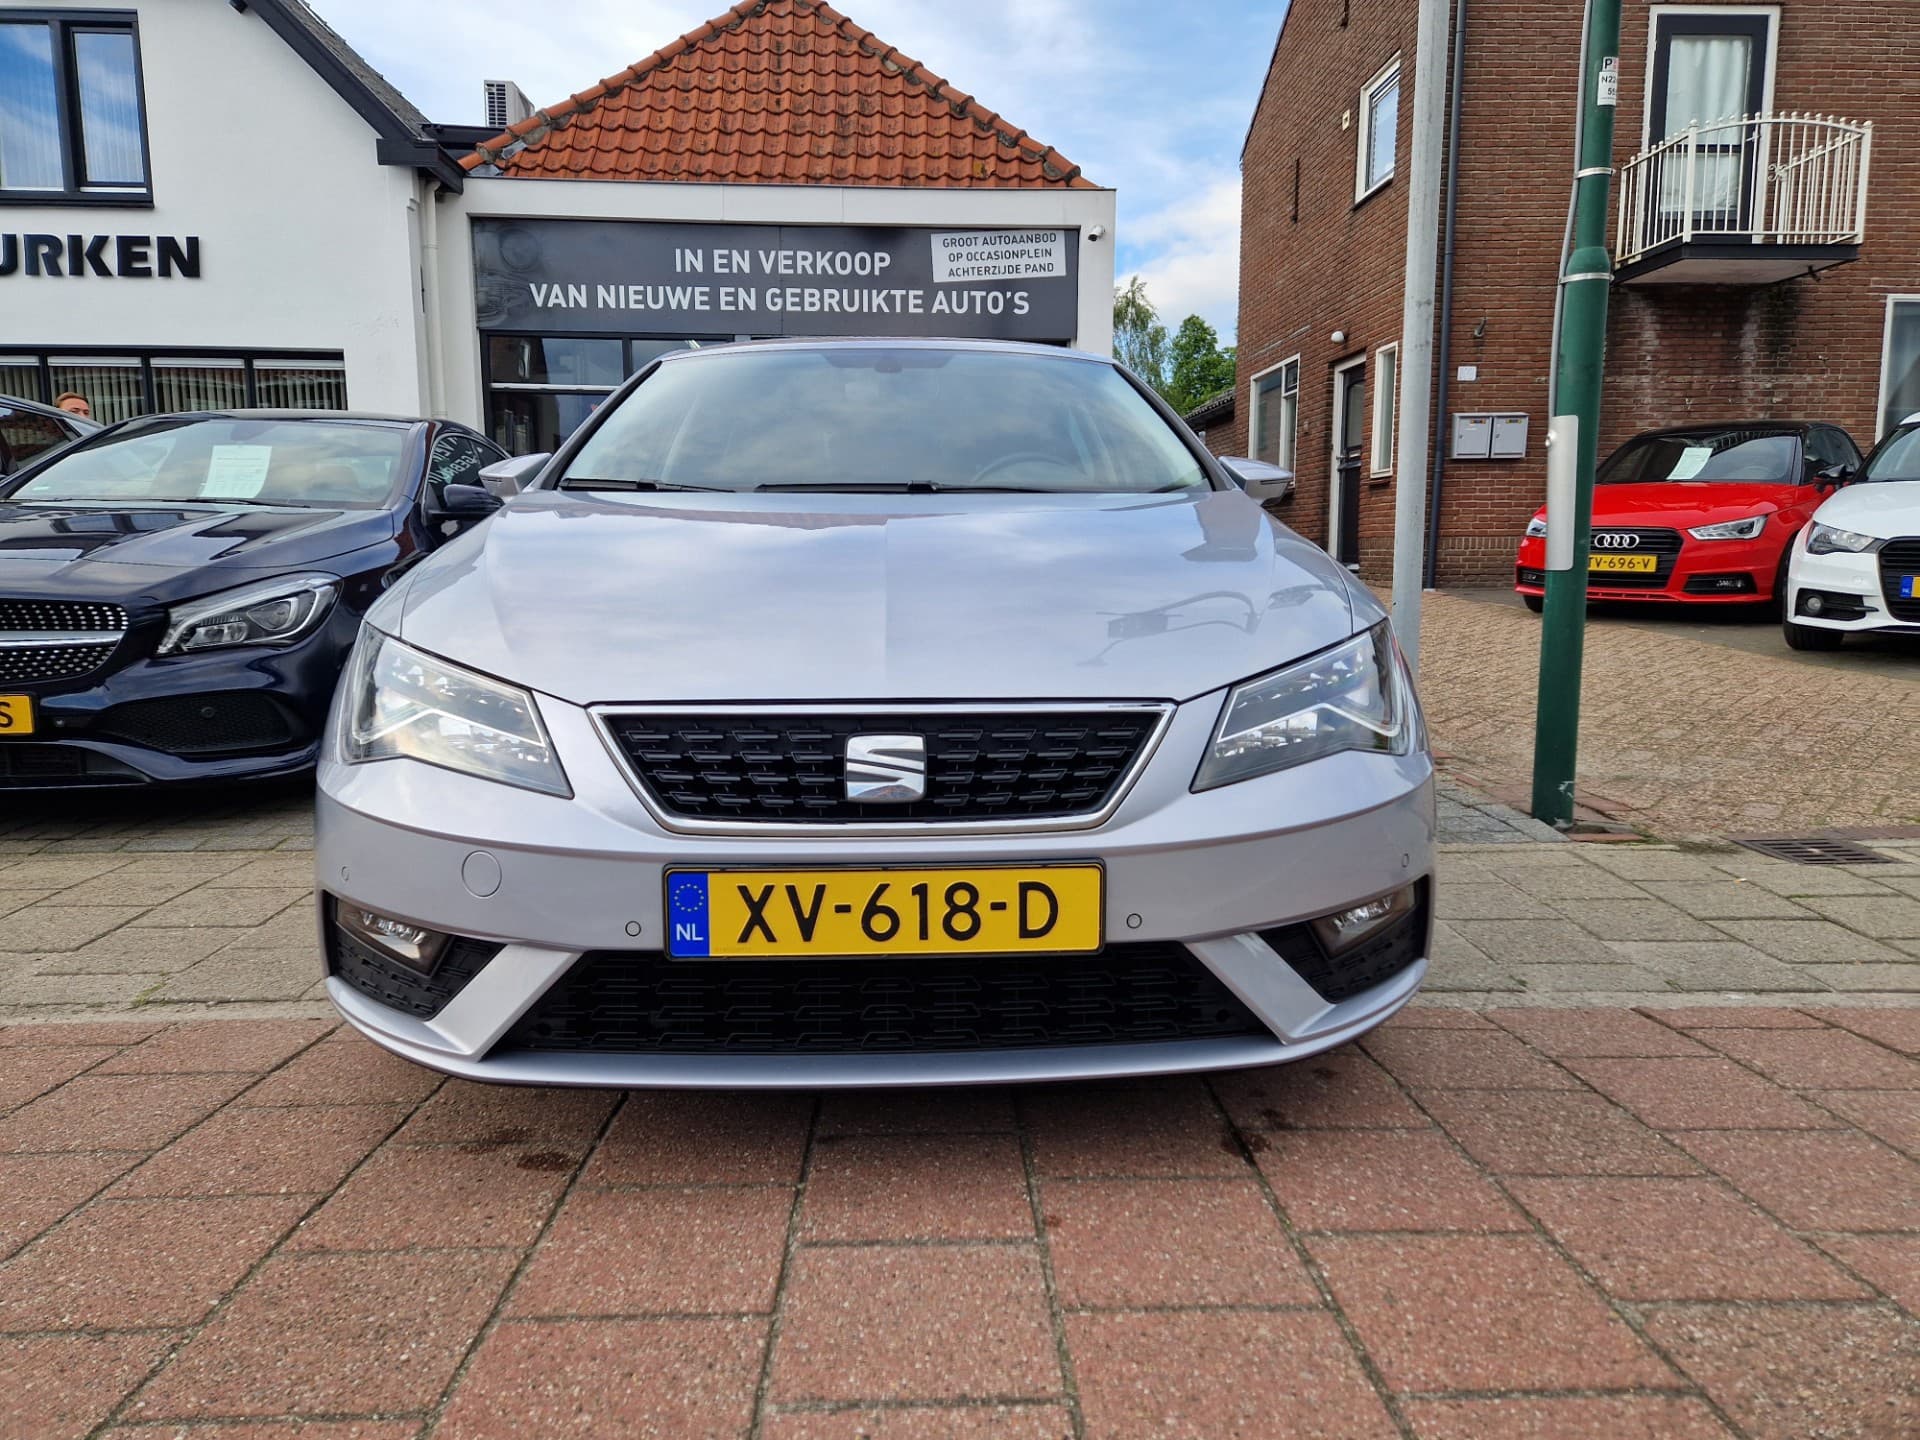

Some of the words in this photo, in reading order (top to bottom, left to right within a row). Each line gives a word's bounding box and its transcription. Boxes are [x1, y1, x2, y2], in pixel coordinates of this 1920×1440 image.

[942, 236, 979, 248] GROOT
[982, 232, 1057, 246] AUTOAANBOD
[675, 248, 704, 273] IN
[713, 249, 750, 274] EN
[758, 250, 891, 276] VERKOOP
[948, 252, 963, 262] OP
[966, 247, 1052, 262] OCCASIONPLEIN
[948, 264, 1021, 277] ACHTERZIJDE
[1024, 262, 1054, 274] PAND
[529, 283, 587, 308] VAN
[597, 284, 710, 310] NIEUWE
[719, 287, 756, 311] EN
[765, 287, 924, 313] GEBRUIKTE
[931, 290, 1030, 315] AUTO'S
[676, 923, 704, 941] NL
[736, 881, 1059, 943] XV-618-D
